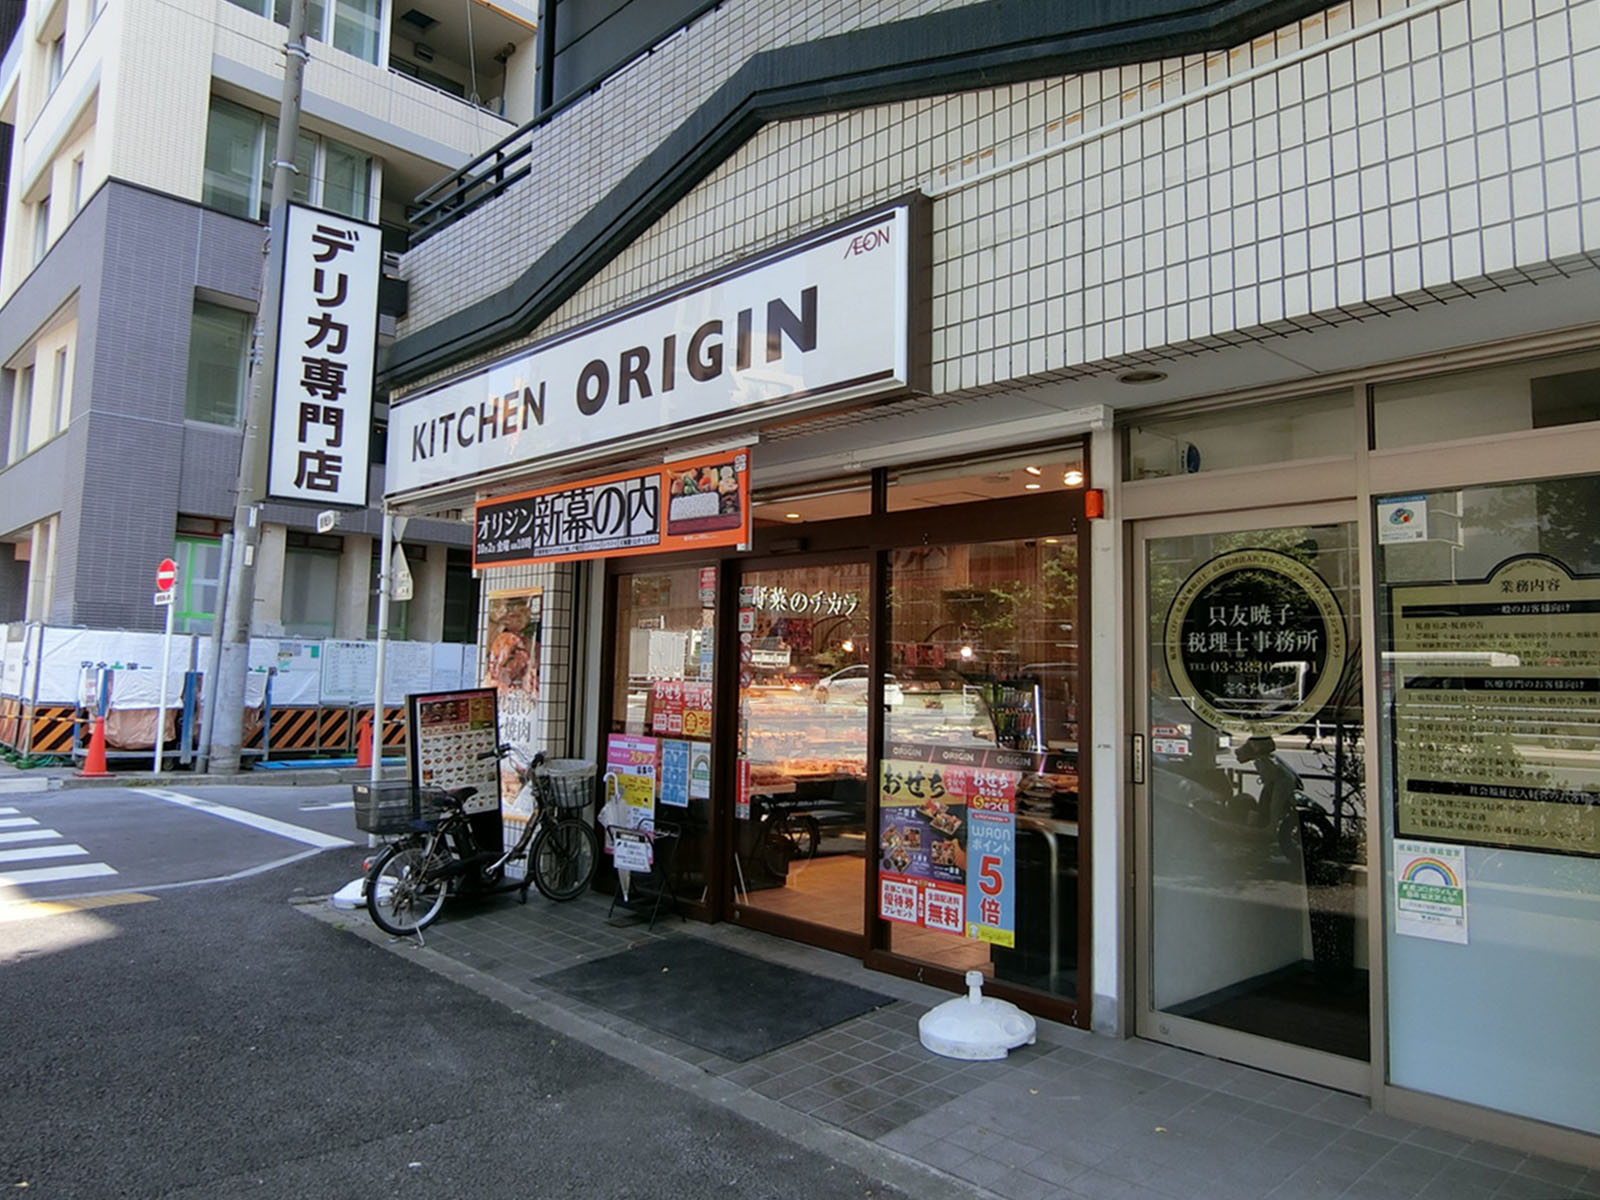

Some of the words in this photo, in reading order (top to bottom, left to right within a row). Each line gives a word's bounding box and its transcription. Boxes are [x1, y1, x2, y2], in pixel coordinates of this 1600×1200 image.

[293, 224, 361, 493] デリカ専門店
[411, 381, 547, 463] KITCHEN
[576, 285, 818, 417] ORIGIN
[477, 508, 534, 540] オリジン
[534, 476, 660, 547] 新幕の内
[1501, 578, 1561, 594] 業務内容
[1187, 629, 1319, 654] 税理士事務所
[941, 750, 975, 763] ORIGIN
[996, 755, 1032, 768] ORIGIN
[882, 763, 946, 799] おせち
[972, 768, 1009, 790] おせち
[971, 838, 1011, 856] ポイント
[978, 855, 1004, 896] 5
[927, 902, 961, 929] 無料
[979, 897, 1001, 926] 倍
